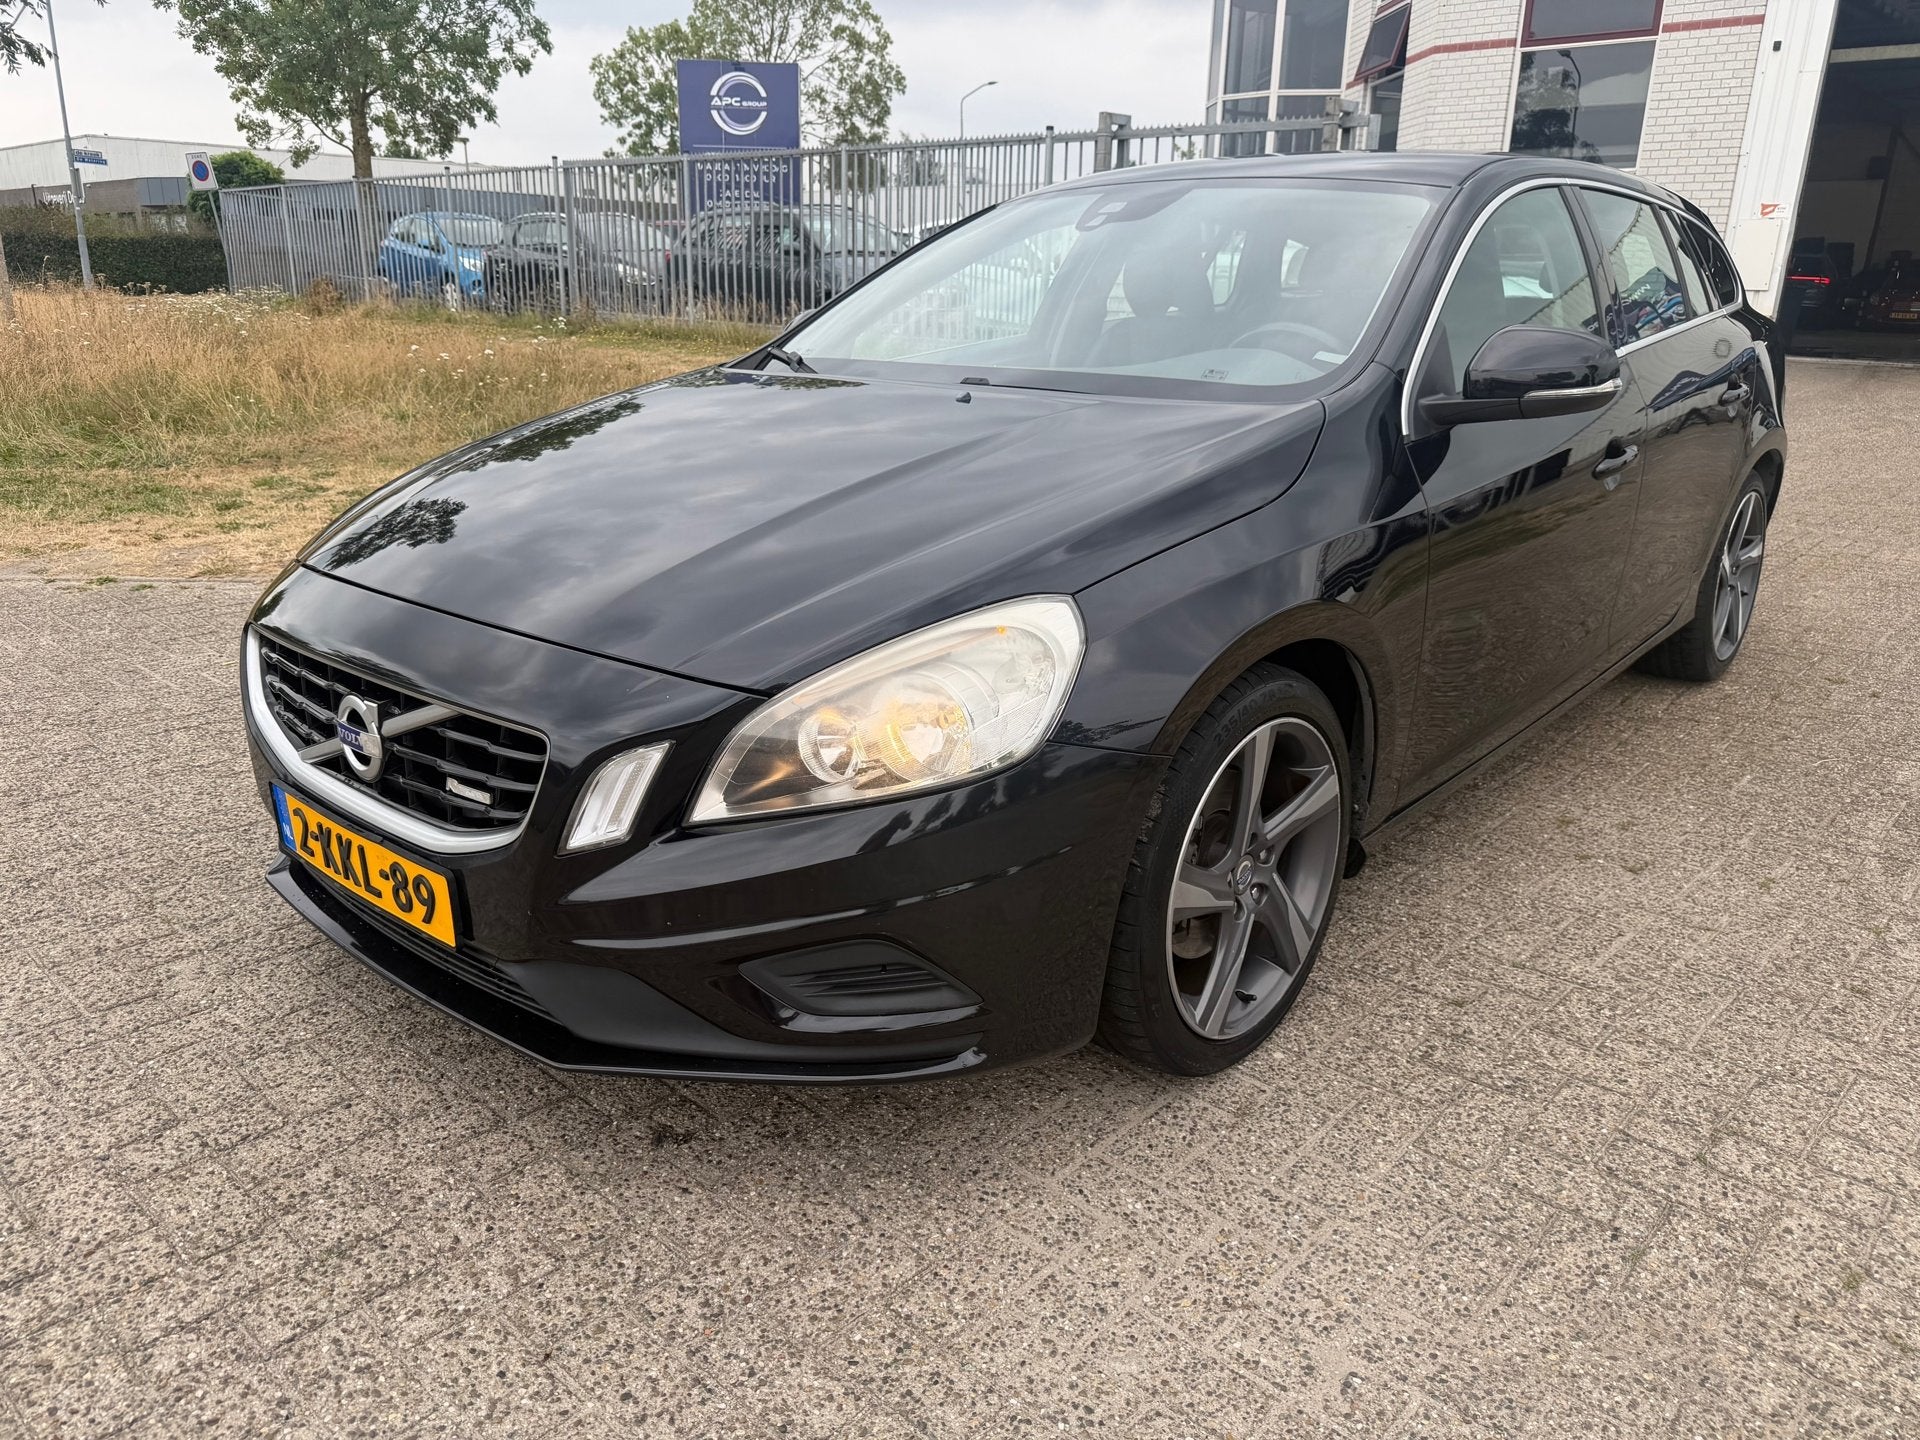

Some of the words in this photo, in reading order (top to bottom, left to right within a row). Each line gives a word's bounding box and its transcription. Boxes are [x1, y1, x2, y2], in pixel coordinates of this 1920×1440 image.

[710, 97, 741, 106] APC
[282, 822, 294, 841] NL
[292, 807, 436, 925] 2-KKL-89
